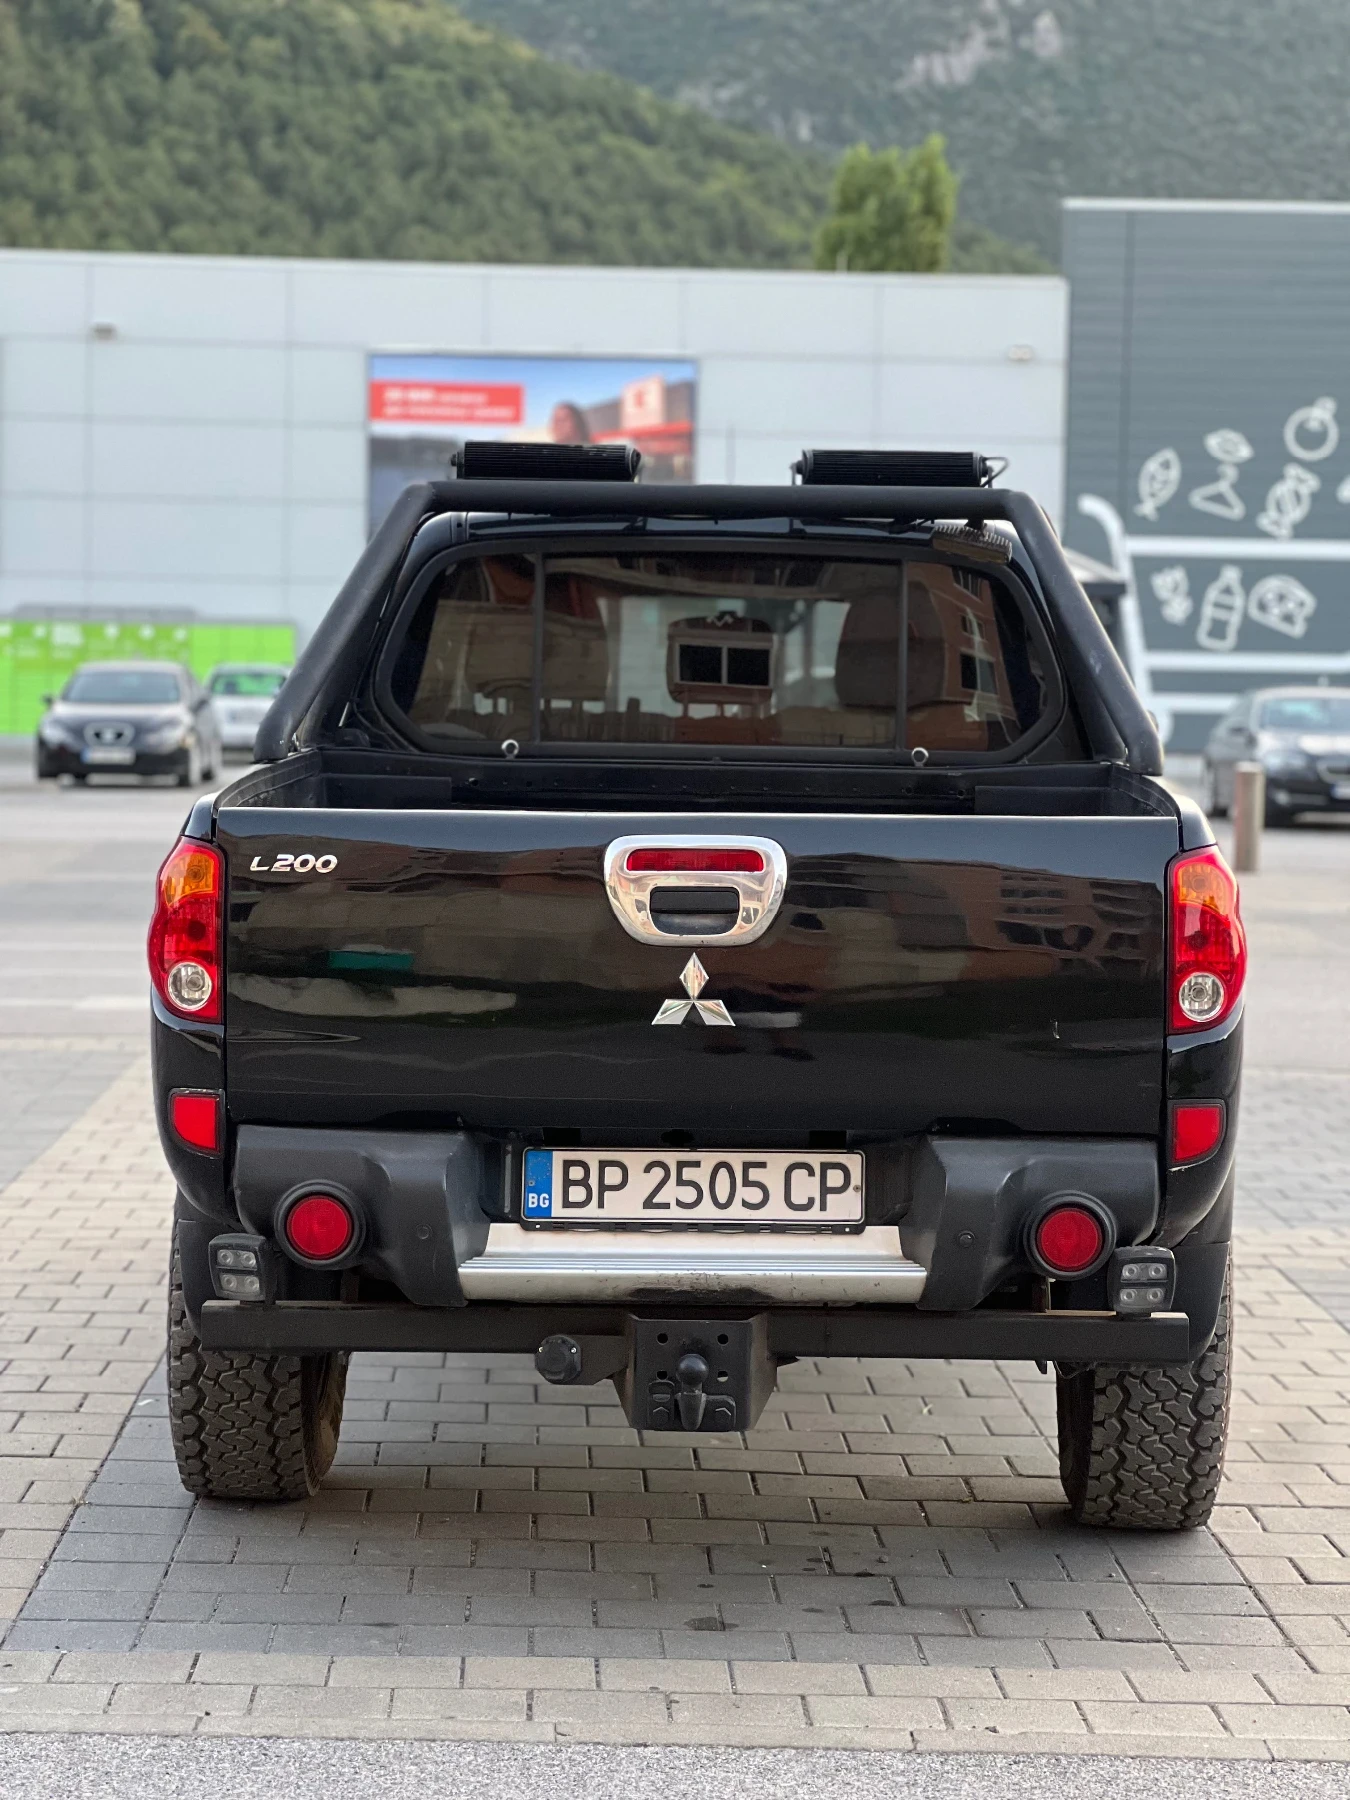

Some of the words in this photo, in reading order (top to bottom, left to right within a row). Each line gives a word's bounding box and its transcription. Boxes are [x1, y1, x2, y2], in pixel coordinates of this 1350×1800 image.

[250, 854, 338, 873] L200
[562, 1160, 629, 1209] BP
[642, 1160, 770, 1211] 2505
[784, 1161, 851, 1212] CP
[528, 1193, 550, 1208] BG
